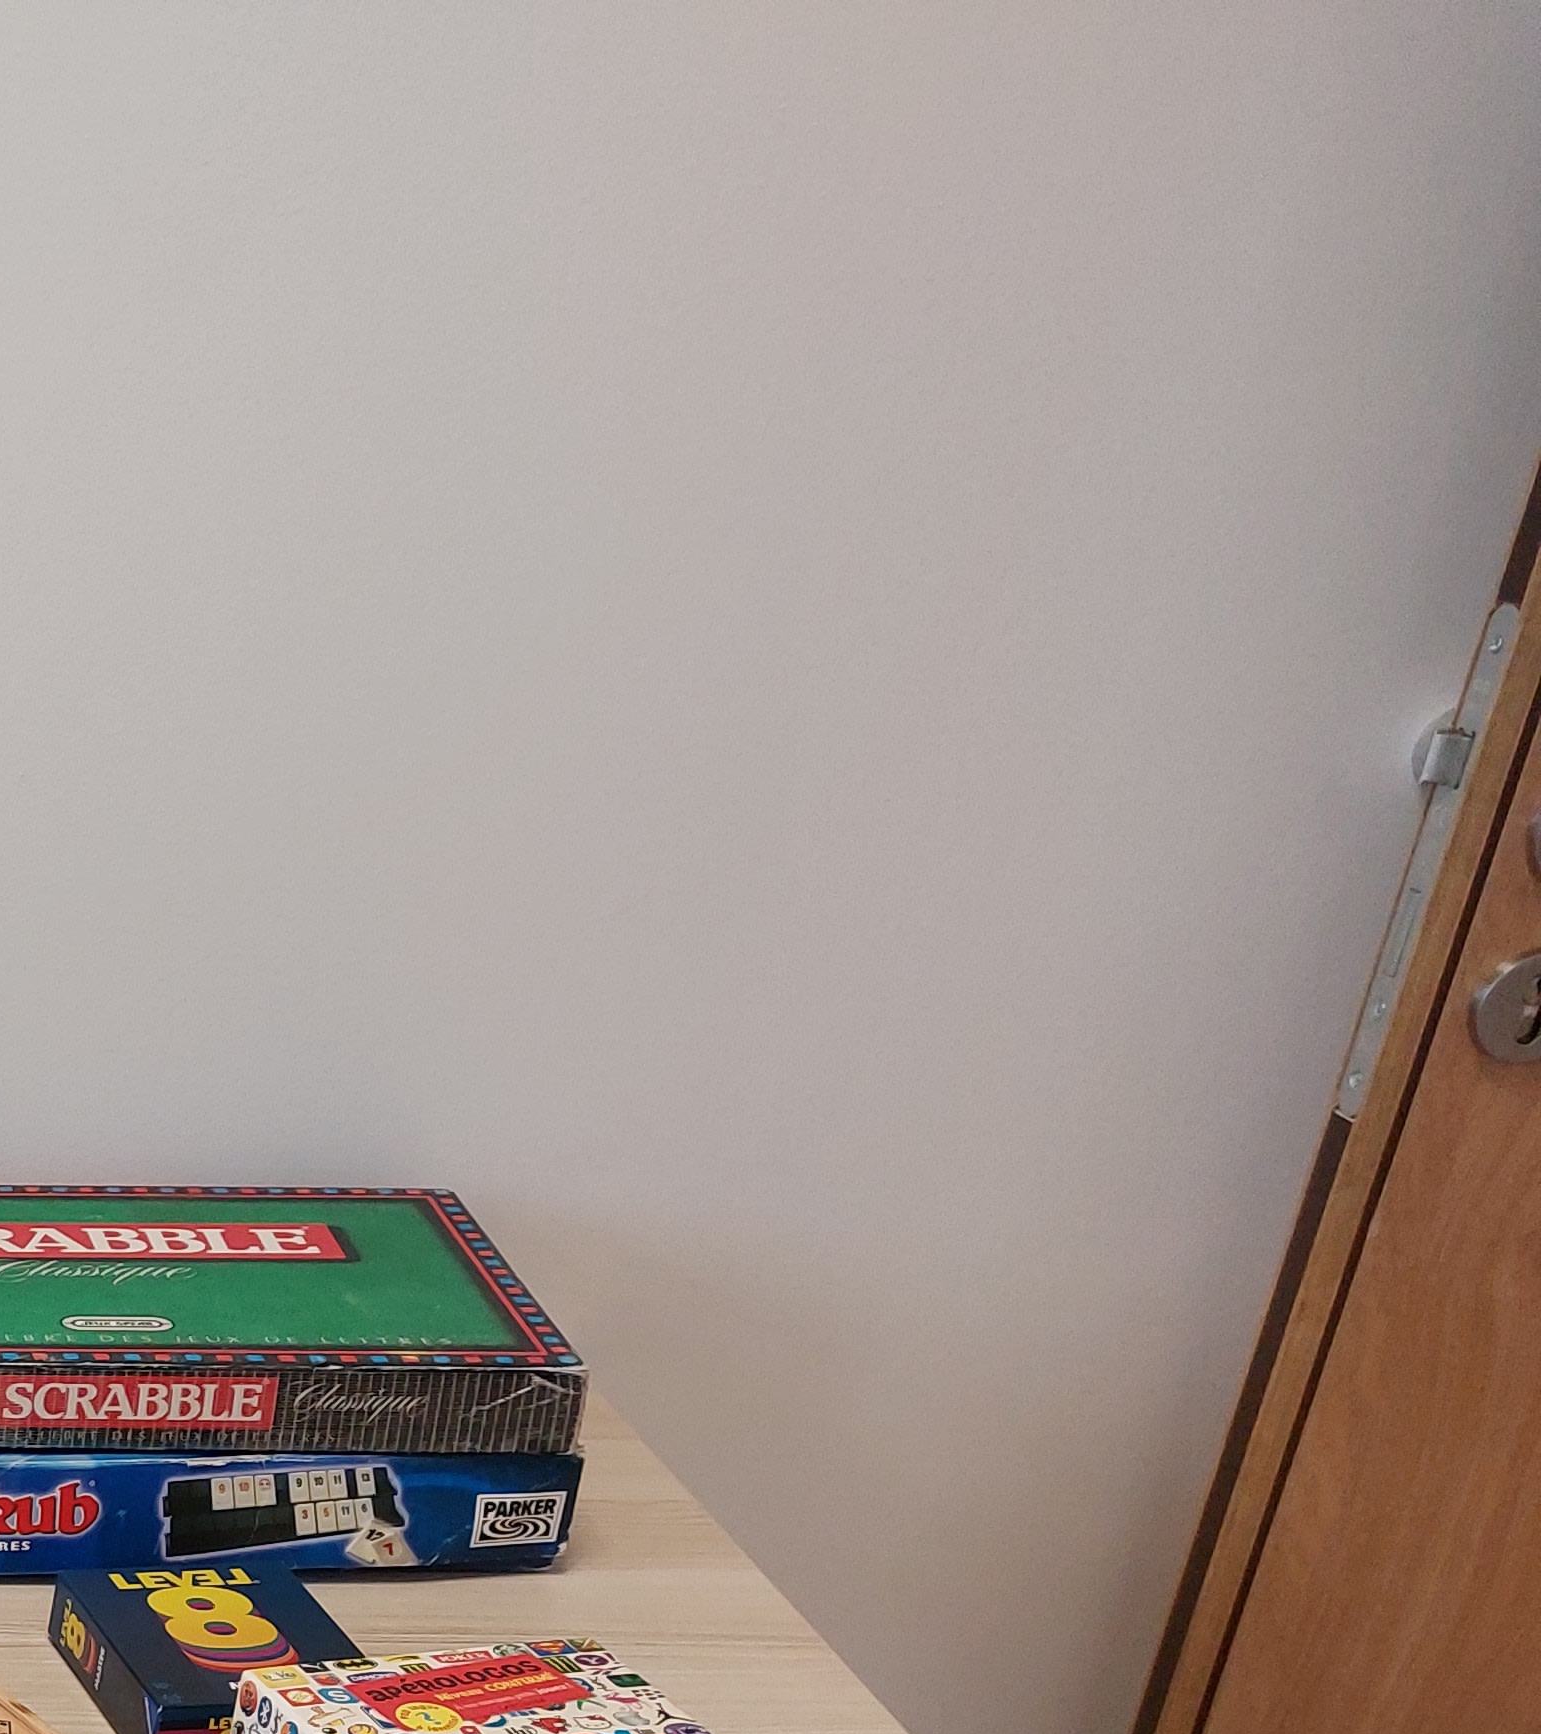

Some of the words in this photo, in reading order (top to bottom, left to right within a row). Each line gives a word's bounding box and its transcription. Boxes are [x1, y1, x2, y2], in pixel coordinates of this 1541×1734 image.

[2, 1381, 264, 1421] SCRABBLE
[291, 1381, 429, 1424] Classique
[482, 1498, 556, 1518] PARKER
[108, 1567, 256, 1590] LEVEL
[146, 1585, 280, 1650] 8
